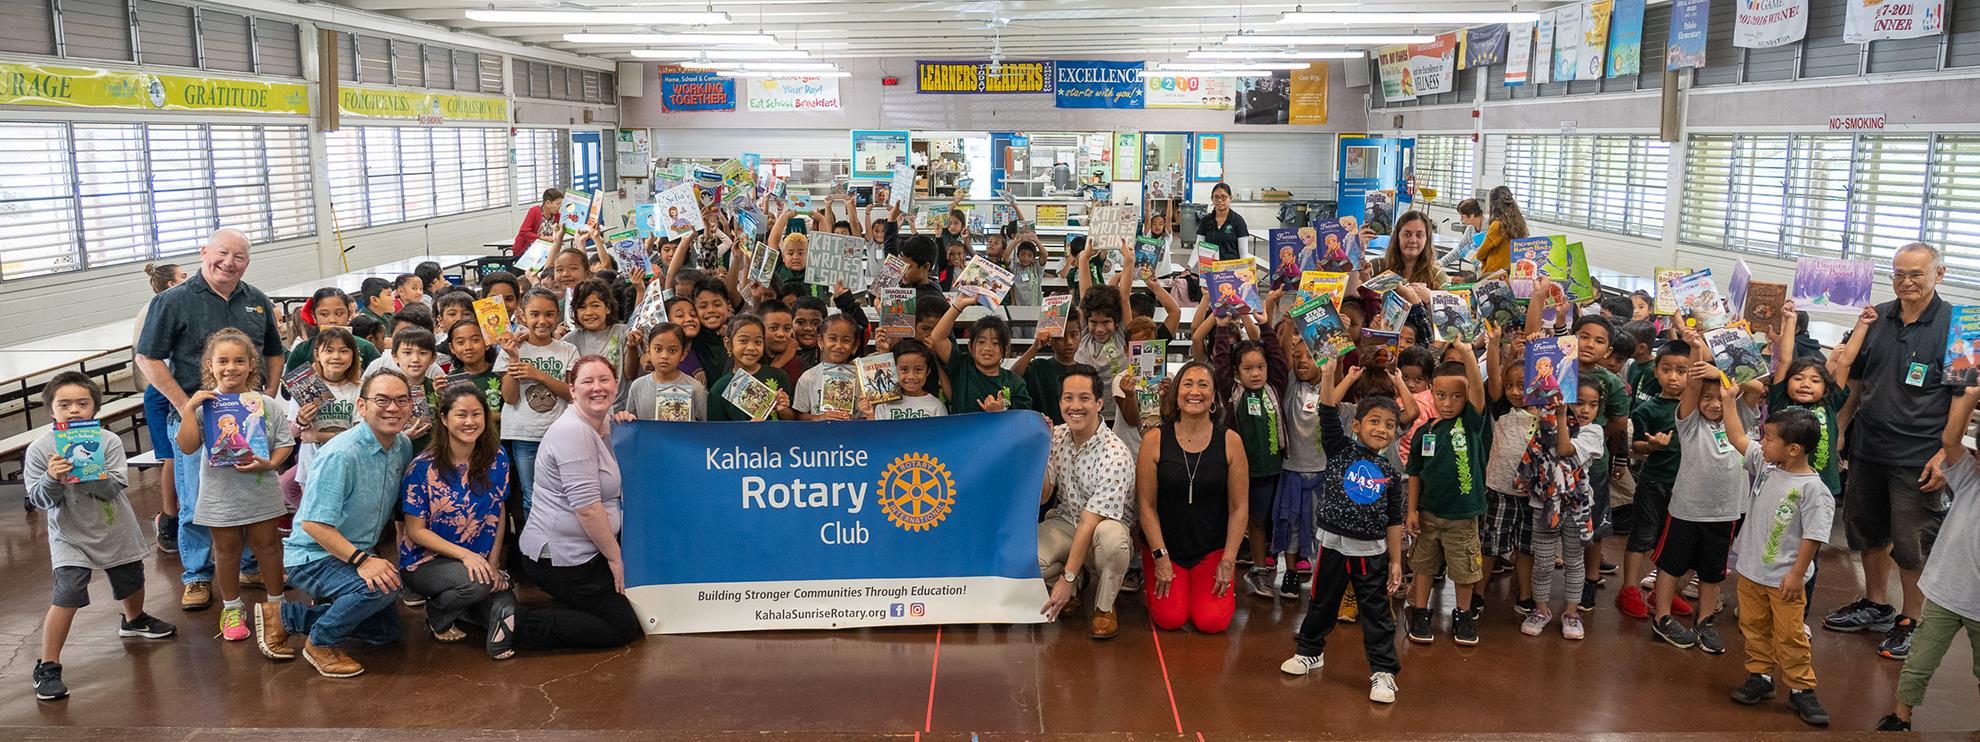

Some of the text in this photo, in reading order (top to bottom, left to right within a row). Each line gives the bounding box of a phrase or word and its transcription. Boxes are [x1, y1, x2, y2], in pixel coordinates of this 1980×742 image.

[681, 75, 698, 83] School
[920, 63, 978, 91] LEARNERS
[978, 64, 986, 93] TODAY
[986, 62, 1043, 91] LEADERS
[1057, 67, 1143, 83] EXCELLENCE
[184, 84, 268, 108] GRATITUDE
[672, 82, 724, 95] WORKING
[782, 84, 823, 97] Your Day!
[1065, 86, 1136, 103] starts with you!
[343, 91, 411, 112] FORGIVENESS
[447, 98, 492, 115] COMPASSION
[669, 93, 728, 105] TOGETHER!
[749, 97, 839, 109] Eat School Breakfast
[1828, 117, 1885, 130] NO-SMOKING
[1092, 206, 1121, 223] KAT
[1089, 220, 1136, 236] WRITES
[1320, 221, 1340, 231] Frozen
[810, 232, 844, 254] KAT
[1276, 232, 1298, 241] Frozen
[808, 250, 862, 273] WRITES
[820, 267, 858, 290] SONG
[1304, 311, 1327, 324] WARS
[1305, 306, 1326, 317] STAR
[1533, 343, 1557, 352] Frozen
[212, 400, 239, 409] Frozen
[321, 400, 354, 415] alolo
[706, 444, 868, 470] Kahala Sunrise
[900, 460, 933, 471] ROTARY
[1346, 471, 1381, 494] NASA
[741, 475, 868, 514] Rotary
[889, 503, 945, 524] INTERNATIONAL
[820, 520, 870, 545] Club
[698, 584, 967, 602] Building Stronger Communities Through Education!
[755, 607, 886, 621] KahalaSunriseRotary.org
